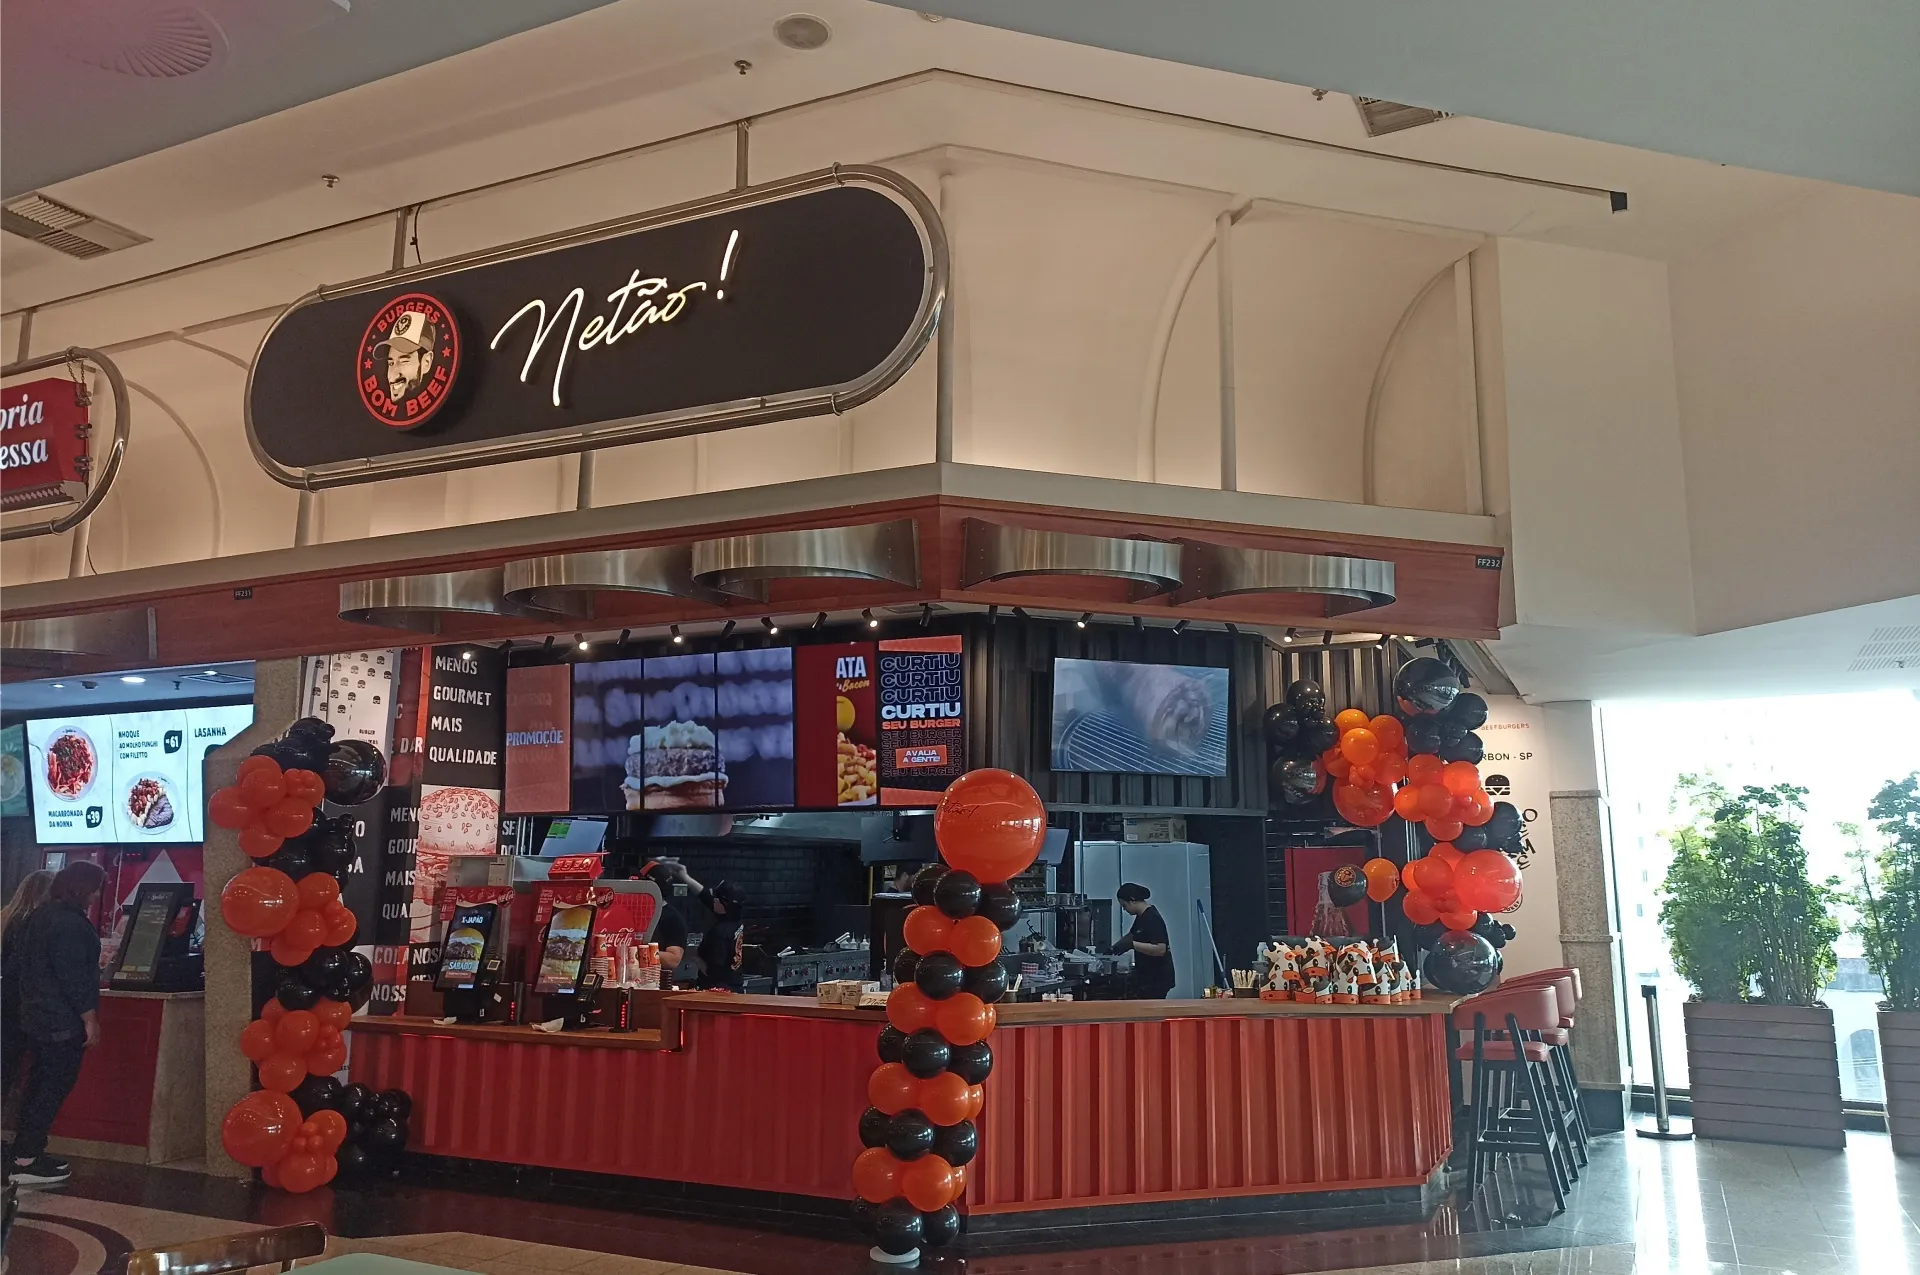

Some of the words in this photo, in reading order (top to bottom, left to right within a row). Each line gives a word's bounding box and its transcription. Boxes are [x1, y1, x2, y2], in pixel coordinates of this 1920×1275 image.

[377, 301, 441, 333] BURGERS
[489, 229, 740, 406] Netão!
[363, 375, 399, 417] BOM
[406, 366, 448, 417] BEEF
[0, 438, 49, 469] essa
[1477, 558, 1501, 567] FF232
[435, 654, 478, 675] MENOS
[836, 656, 867, 678] ATA
[880, 653, 961, 672] CURTIU
[842, 679, 870, 692] Bacon
[880, 669, 961, 688] CURTIU
[432, 685, 492, 706] GOURMET
[880, 686, 961, 704] CURTIU
[881, 702, 961, 720] CURTIU
[194, 726, 227, 738] LASANHA
[430, 715, 463, 732] MAIS
[882, 720, 907, 730] SEU
[910, 718, 961, 729] BURGER
[118, 730, 140, 738] NHOQUE
[882, 730, 907, 741] SEU
[910, 729, 961, 739] BURGER
[429, 746, 498, 766] QUALIDADE
[905, 749, 937, 757] AVALIA
[1519, 752, 1533, 761] SP
[911, 767, 961, 777] BURGER
